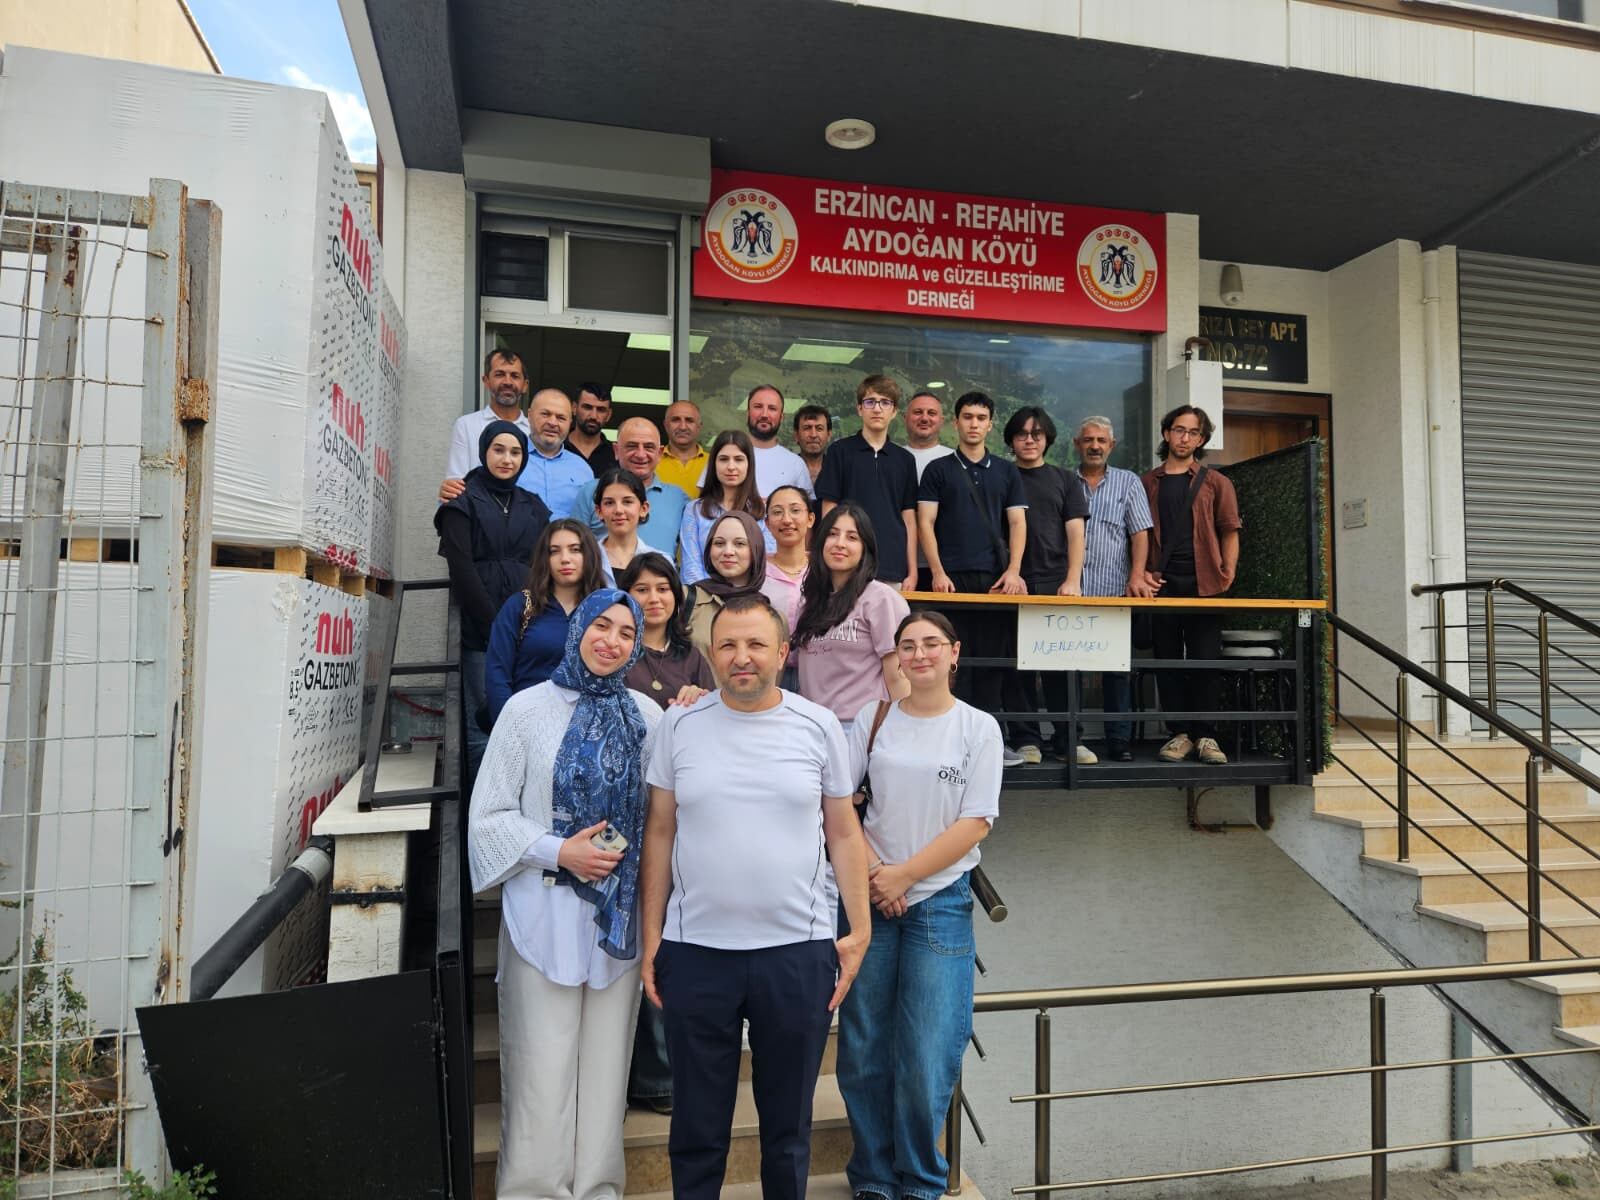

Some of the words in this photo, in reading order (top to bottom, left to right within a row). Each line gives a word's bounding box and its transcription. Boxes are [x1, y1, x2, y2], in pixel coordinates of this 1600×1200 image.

[815, 185, 935, 225] ERZİNCAN
[956, 202, 1064, 237] REFAHİYE
[341, 202, 373, 294] nuh
[842, 227, 964, 261] AYDOĞAN
[971, 234, 1038, 267] KÖYÜ
[332, 234, 375, 334] GAZBETON
[810, 255, 919, 281] KALKINDIRMA
[922, 268, 939, 283] ve
[943, 263, 1065, 294] GÜZELLEŞTİRME
[907, 288, 975, 311] DERNEĞİ
[1269, 321, 1299, 342] APT.
[331, 383, 365, 453] nuh
[322, 423, 367, 490] GAZBETON
[315, 608, 354, 656] nuh
[1043, 614, 1099, 631] TOST
[303, 659, 357, 691] GAZBETON
